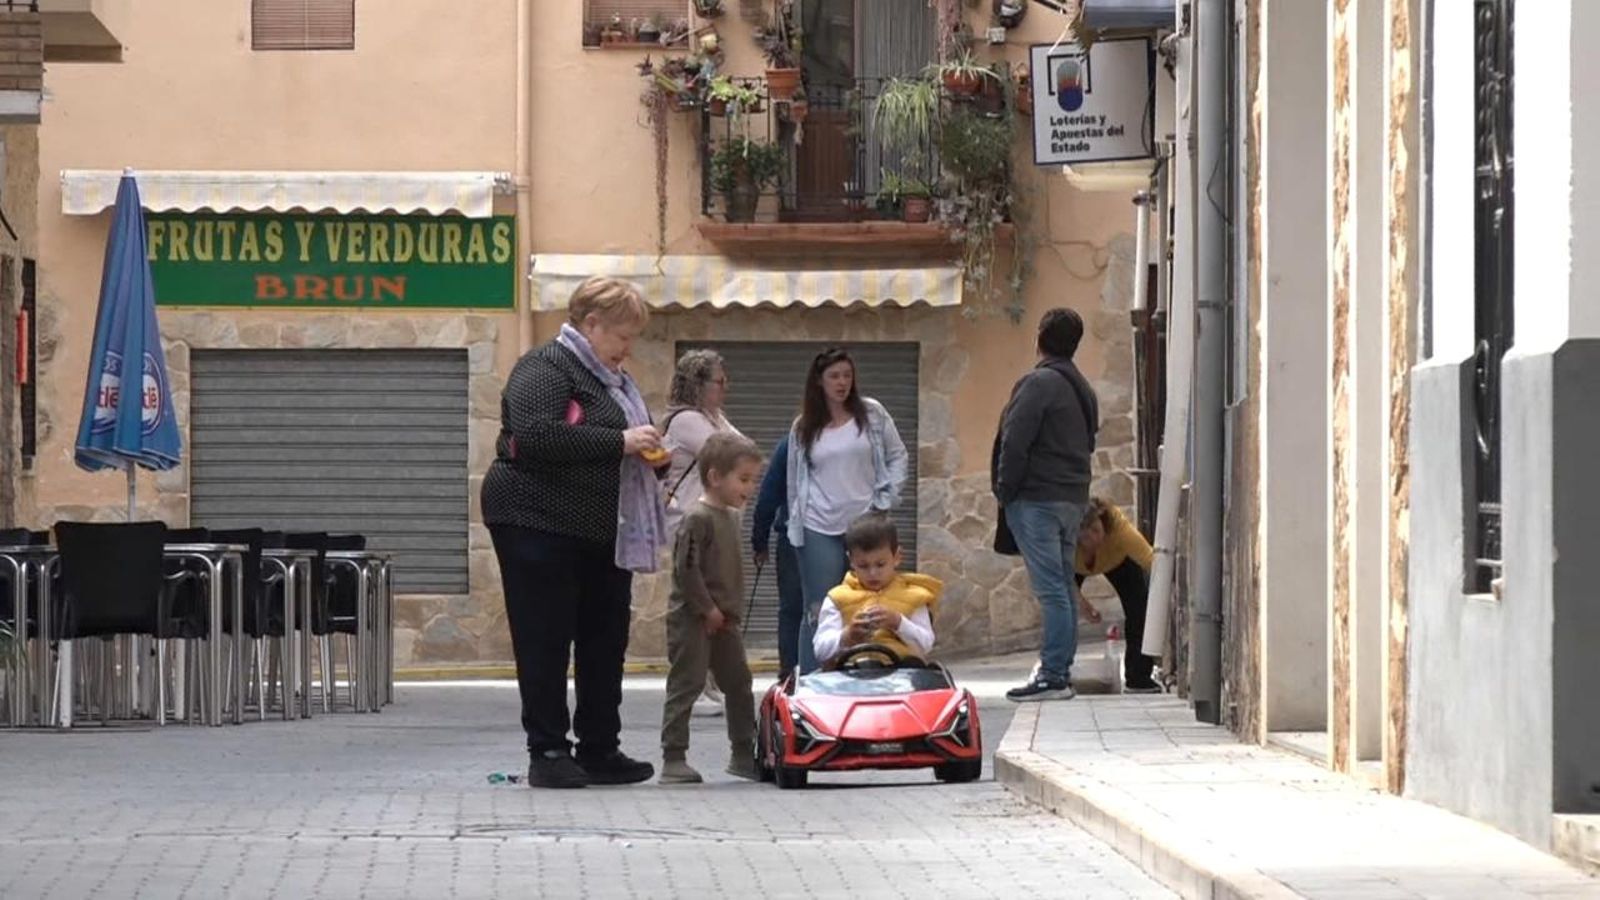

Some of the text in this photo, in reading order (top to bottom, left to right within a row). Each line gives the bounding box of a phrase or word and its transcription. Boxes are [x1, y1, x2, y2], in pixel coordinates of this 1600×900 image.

[1099, 114, 1106, 126] y
[1051, 124, 1124, 141] Apuestas del
[1051, 140, 1090, 153] Estado
[147, 220, 511, 263] FRUTAS Y VERDURAS
[254, 273, 407, 300] BRUN
